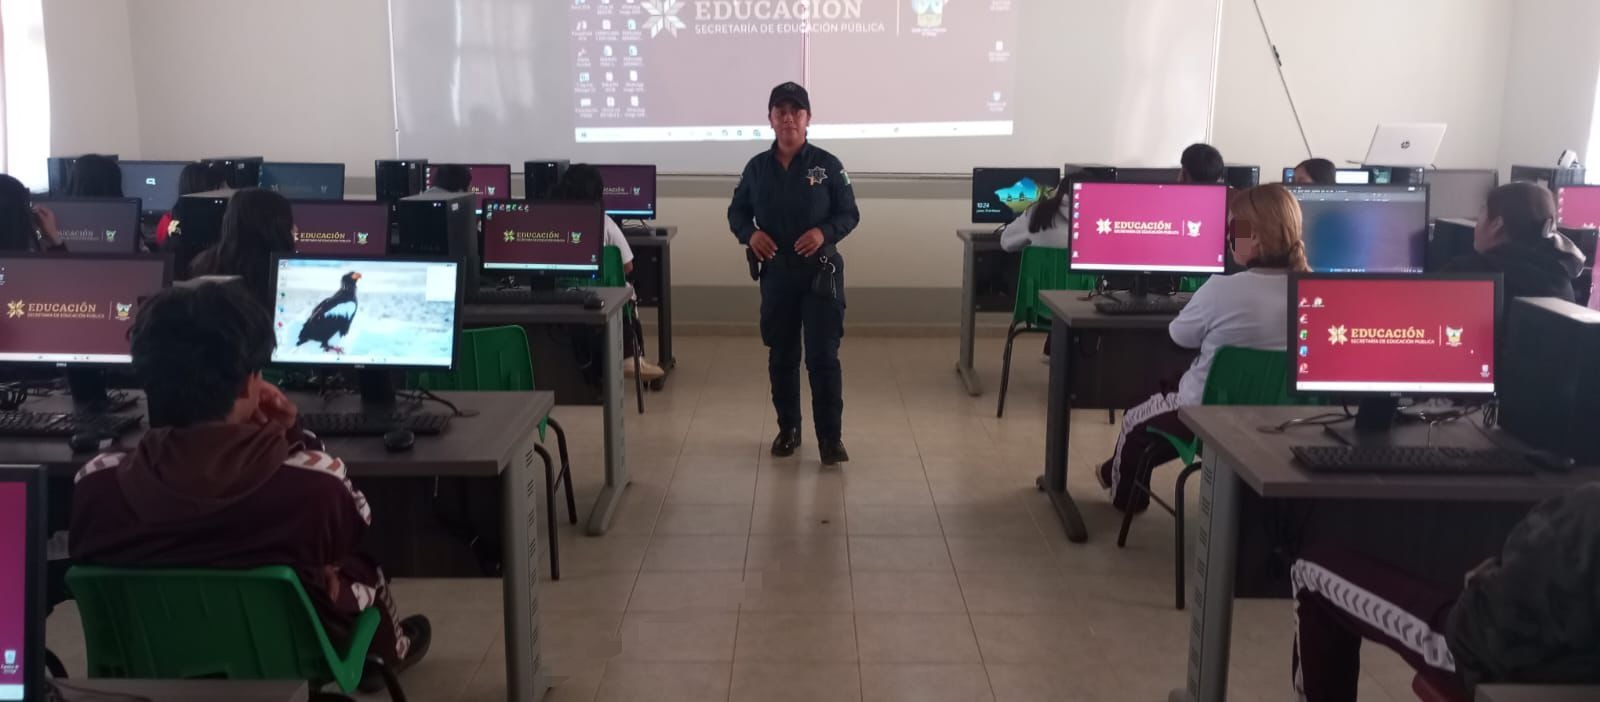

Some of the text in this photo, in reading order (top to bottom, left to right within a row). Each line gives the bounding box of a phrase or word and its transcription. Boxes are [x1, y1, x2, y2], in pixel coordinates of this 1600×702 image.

[760, 23, 774, 33] DE
[1114, 220, 1172, 230] EDUCACIÓN
[28, 302, 97, 313] EDUCACIÓN
[1351, 326, 1425, 338] EDUCACIÓN
